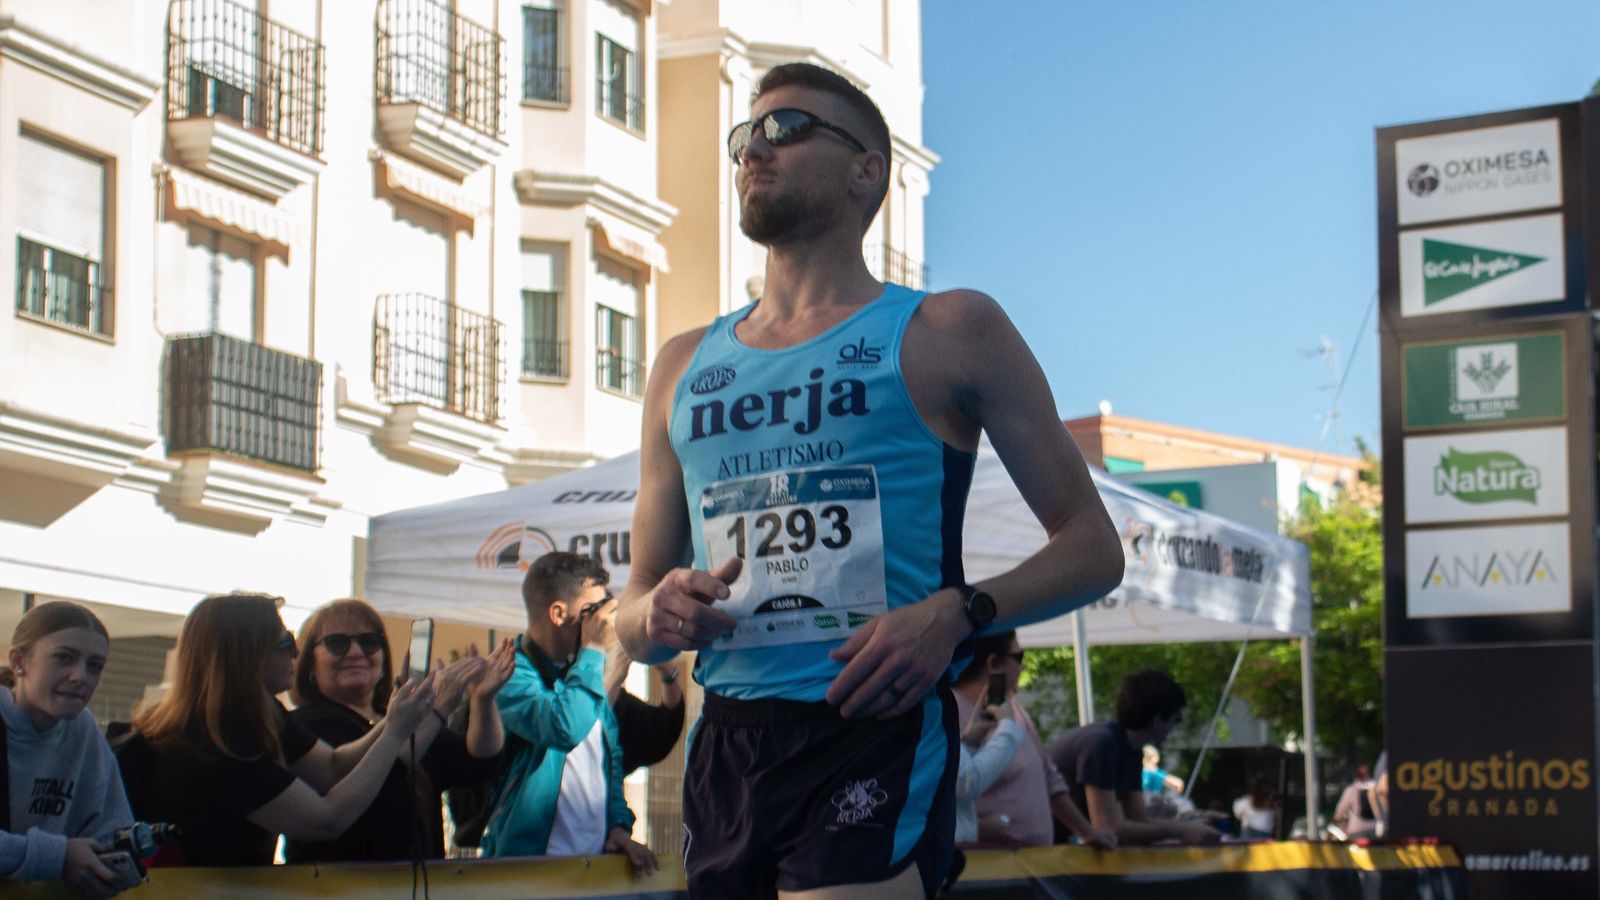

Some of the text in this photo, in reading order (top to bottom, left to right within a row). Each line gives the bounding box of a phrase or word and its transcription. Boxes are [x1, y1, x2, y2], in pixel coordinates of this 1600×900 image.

[1444, 149, 1550, 178] OXIMESA
[689, 367, 870, 442] nerja
[717, 439, 845, 480] ATLETISMO
[1435, 465, 1539, 494] Natura
[727, 505, 853, 560] 1293
[766, 557, 809, 576] PABLO
[1421, 550, 1557, 590] ANAYA
[1396, 751, 1591, 800] agustinos
[28, 798, 66, 816] KIND
[1427, 798, 1559, 817] GRANADA
